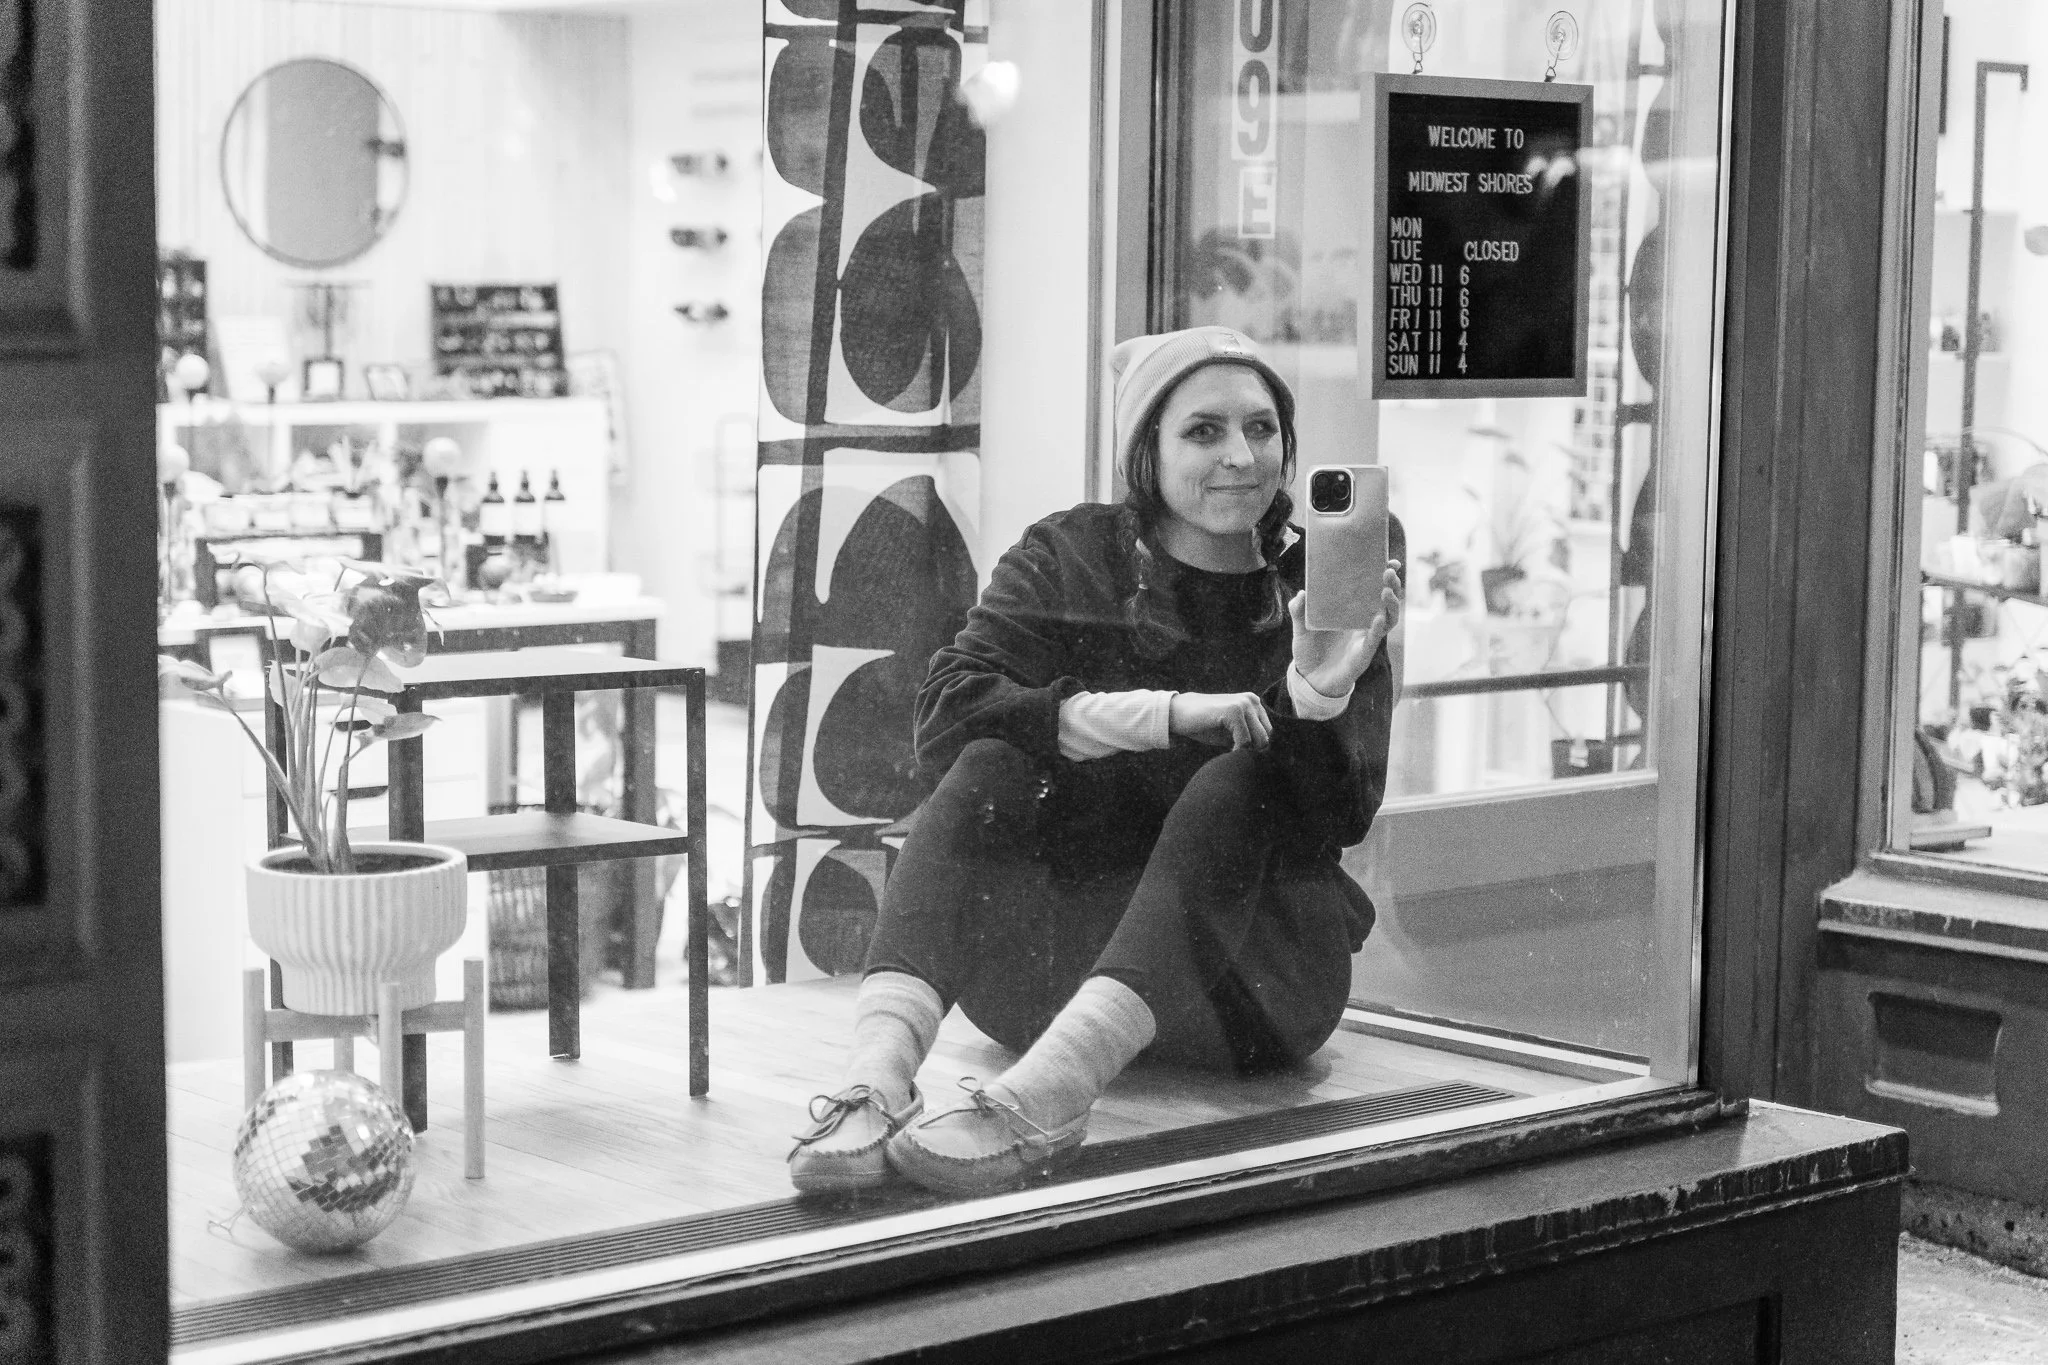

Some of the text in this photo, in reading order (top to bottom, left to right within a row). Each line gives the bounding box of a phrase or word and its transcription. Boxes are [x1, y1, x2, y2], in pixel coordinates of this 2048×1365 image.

[1428, 125, 1525, 149] WELCOME TO
[1408, 171, 1534, 194] MIDWEST SHORES
[1390, 217, 1423, 238] MON
[1391, 240, 1520, 262] TUE CLOSED
[1390, 263, 1470, 286] WED 11 6
[1390, 285, 1470, 308] THU 11 6
[1389, 308, 1470, 330] FRI 11 6
[1388, 331, 1469, 352] SAT 11 4
[1388, 354, 1468, 376] SUN 11 4
